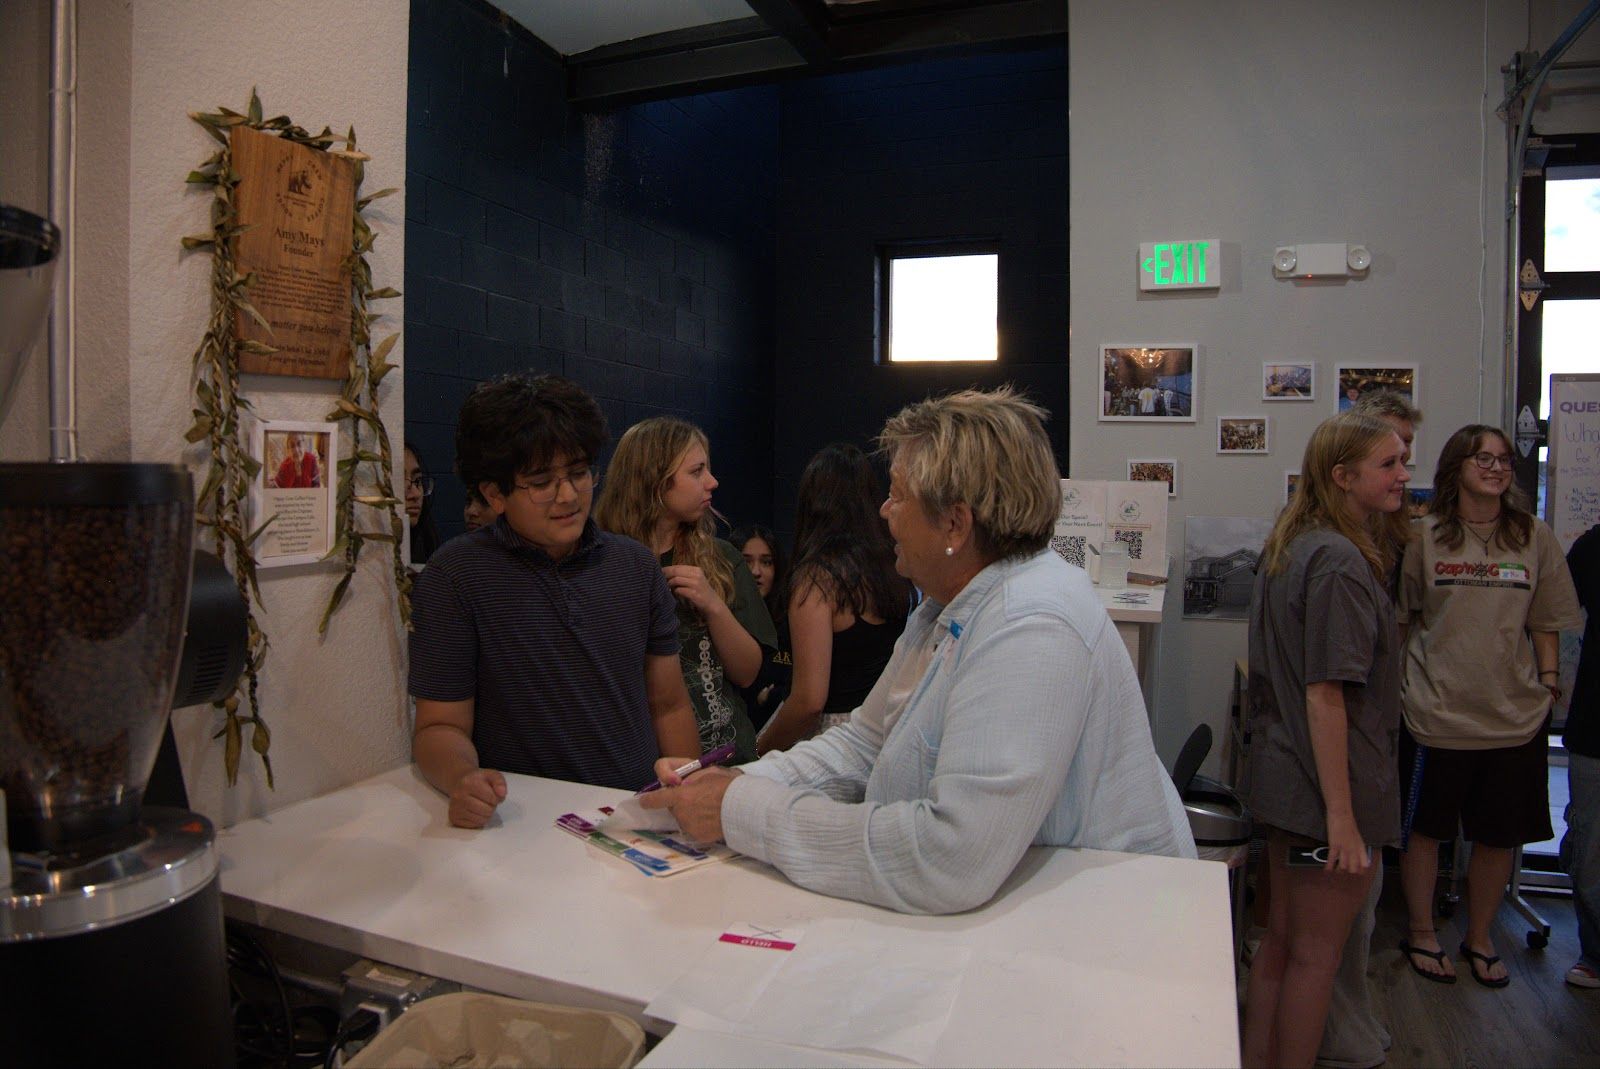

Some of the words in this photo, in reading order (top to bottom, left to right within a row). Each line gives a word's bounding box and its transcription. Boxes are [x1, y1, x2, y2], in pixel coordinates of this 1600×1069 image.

[275, 227, 297, 244] Amy
[283, 243, 315, 257] Founder
[1154, 241, 1209, 285] EXIT
[1560, 401, 1600, 414] QUE
